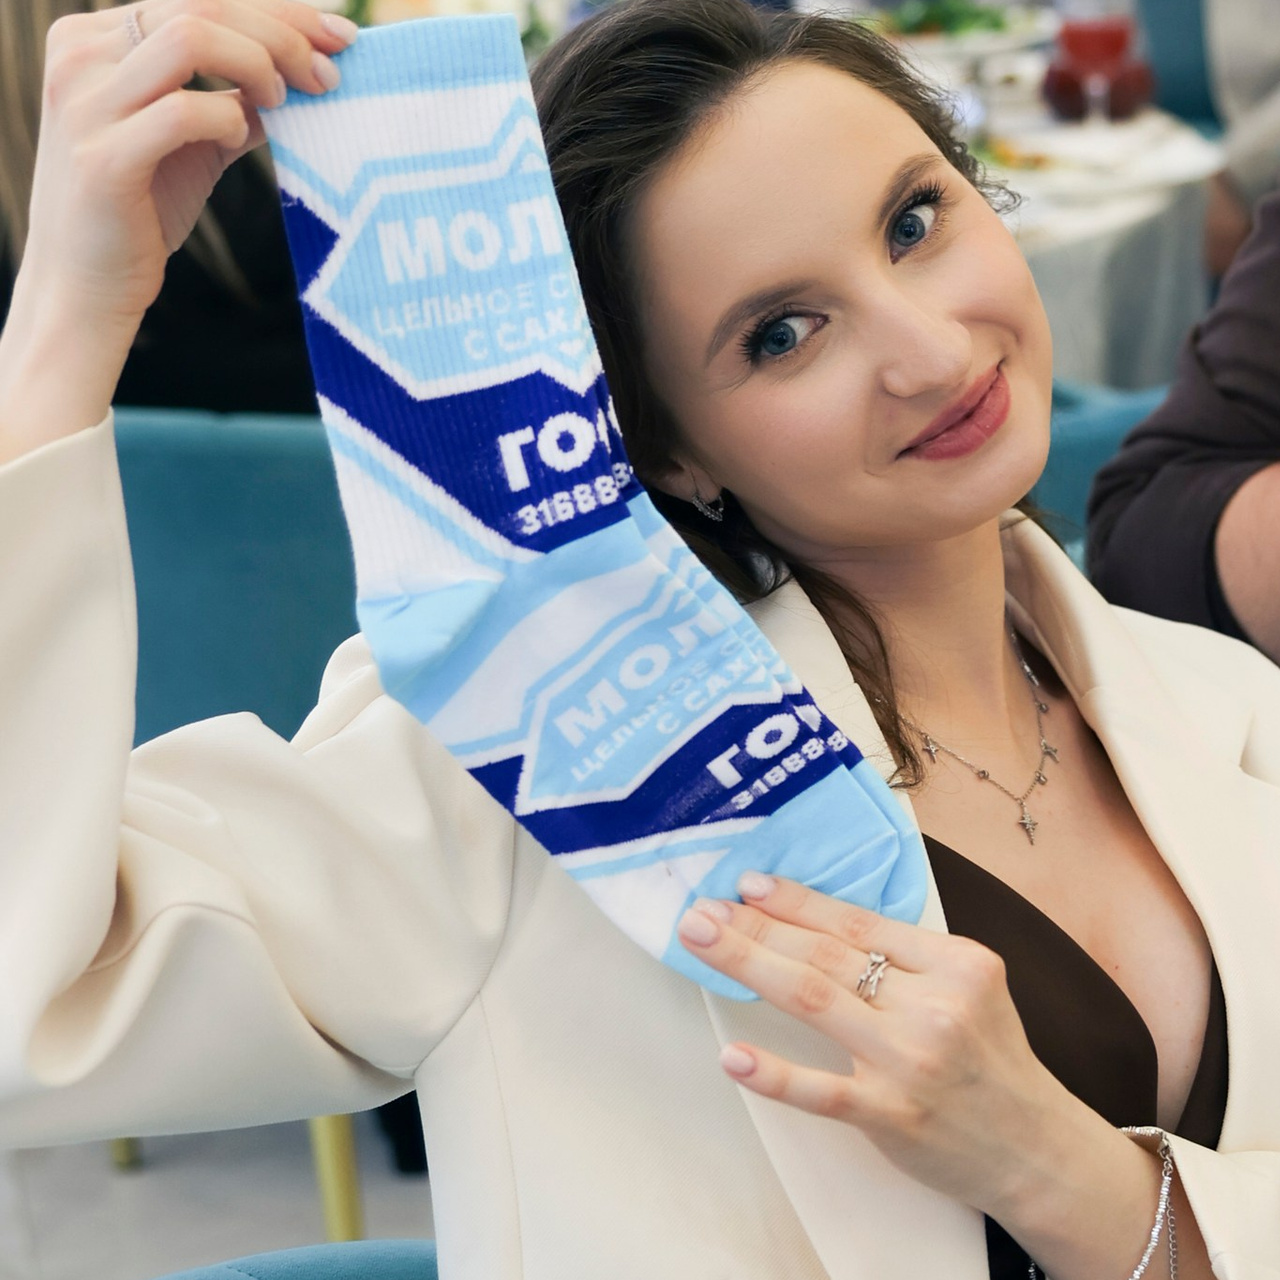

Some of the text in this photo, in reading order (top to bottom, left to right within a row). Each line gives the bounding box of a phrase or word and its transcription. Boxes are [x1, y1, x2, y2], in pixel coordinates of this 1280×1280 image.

[376, 195, 563, 285] МОЛ
[373, 281, 535, 339] ЦЕЛЬНОЕ
[463, 329, 488, 361] С
[498, 407, 611, 493] ГО
[706, 708, 812, 789] ГО
